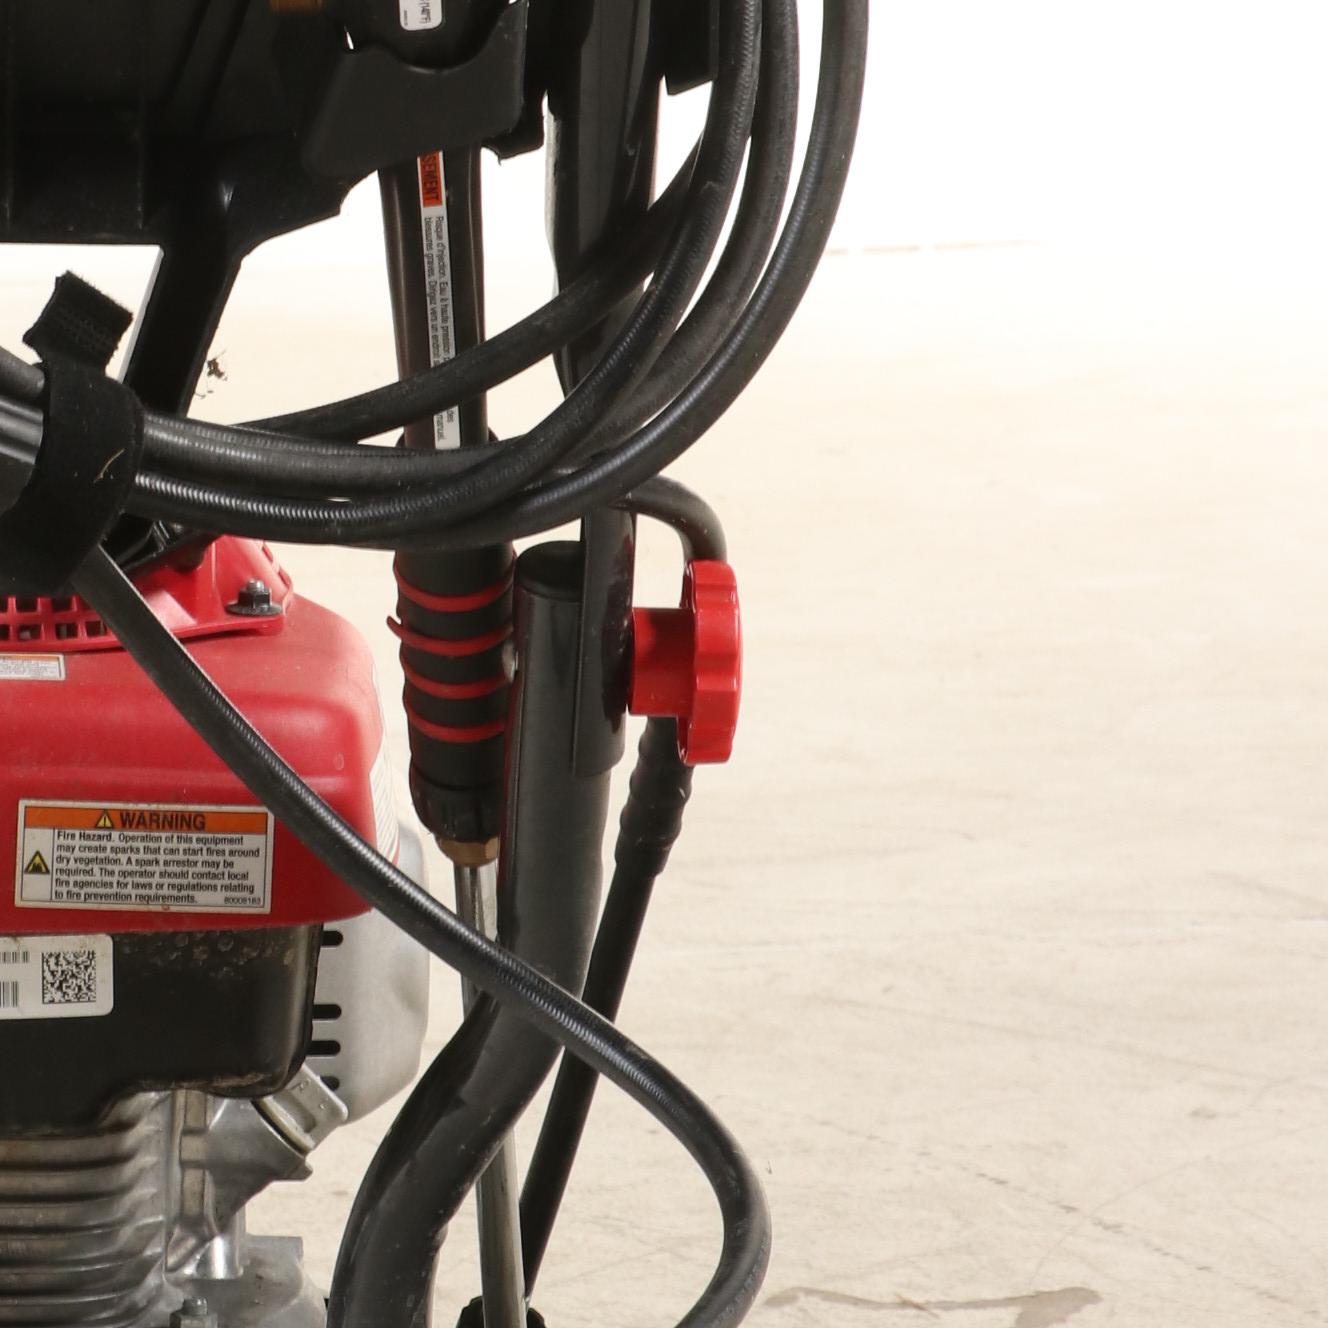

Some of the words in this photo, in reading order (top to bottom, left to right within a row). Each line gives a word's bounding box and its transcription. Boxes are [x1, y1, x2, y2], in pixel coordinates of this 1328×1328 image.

[120, 813, 206, 831] WARNING
[57, 831, 76, 841] Fire
[79, 831, 116, 842] Hazard.
[118, 832, 163, 846] Operation
[165, 834, 176, 844] of
[176, 834, 193, 845] this
[195, 835, 244, 847] equipment
[56, 845, 75, 855] may
[78, 844, 108, 855] create
[110, 845, 141, 857] sparks
[142, 846, 161, 856] that
[163, 848, 180, 856] can
[182, 846, 204, 857] start
[206, 847, 226, 857] fires
[228, 847, 260, 858] around
[55, 855, 72, 866] dry
[73, 856, 123, 868] vegetation.
[125, 857, 133, 867] A
[135, 858, 161, 869] spark
[163, 859, 199, 868] arrestor
[201, 860, 221, 870] may
[223, 859, 235, 868] be
[55, 867, 96, 879] required.
[98, 868, 116, 877] The
[117, 869, 157, 880] operator
[158, 869, 190, 879] should
[191, 871, 225, 881] contact
[227, 870, 249, 881] local
[55, 878, 71, 888] fire
[73, 878, 114, 892] agencies
[116, 879, 130, 889] for
[131, 880, 153, 890] laws
[155, 882, 165, 891] or
[167, 881, 218, 894] regulations
[220, 882, 255, 894] relating
[54, 890, 64, 900] to
[65, 890, 81, 900] fire
[83, 891, 133, 904] prevention
[134, 892, 198, 905] requirements.
